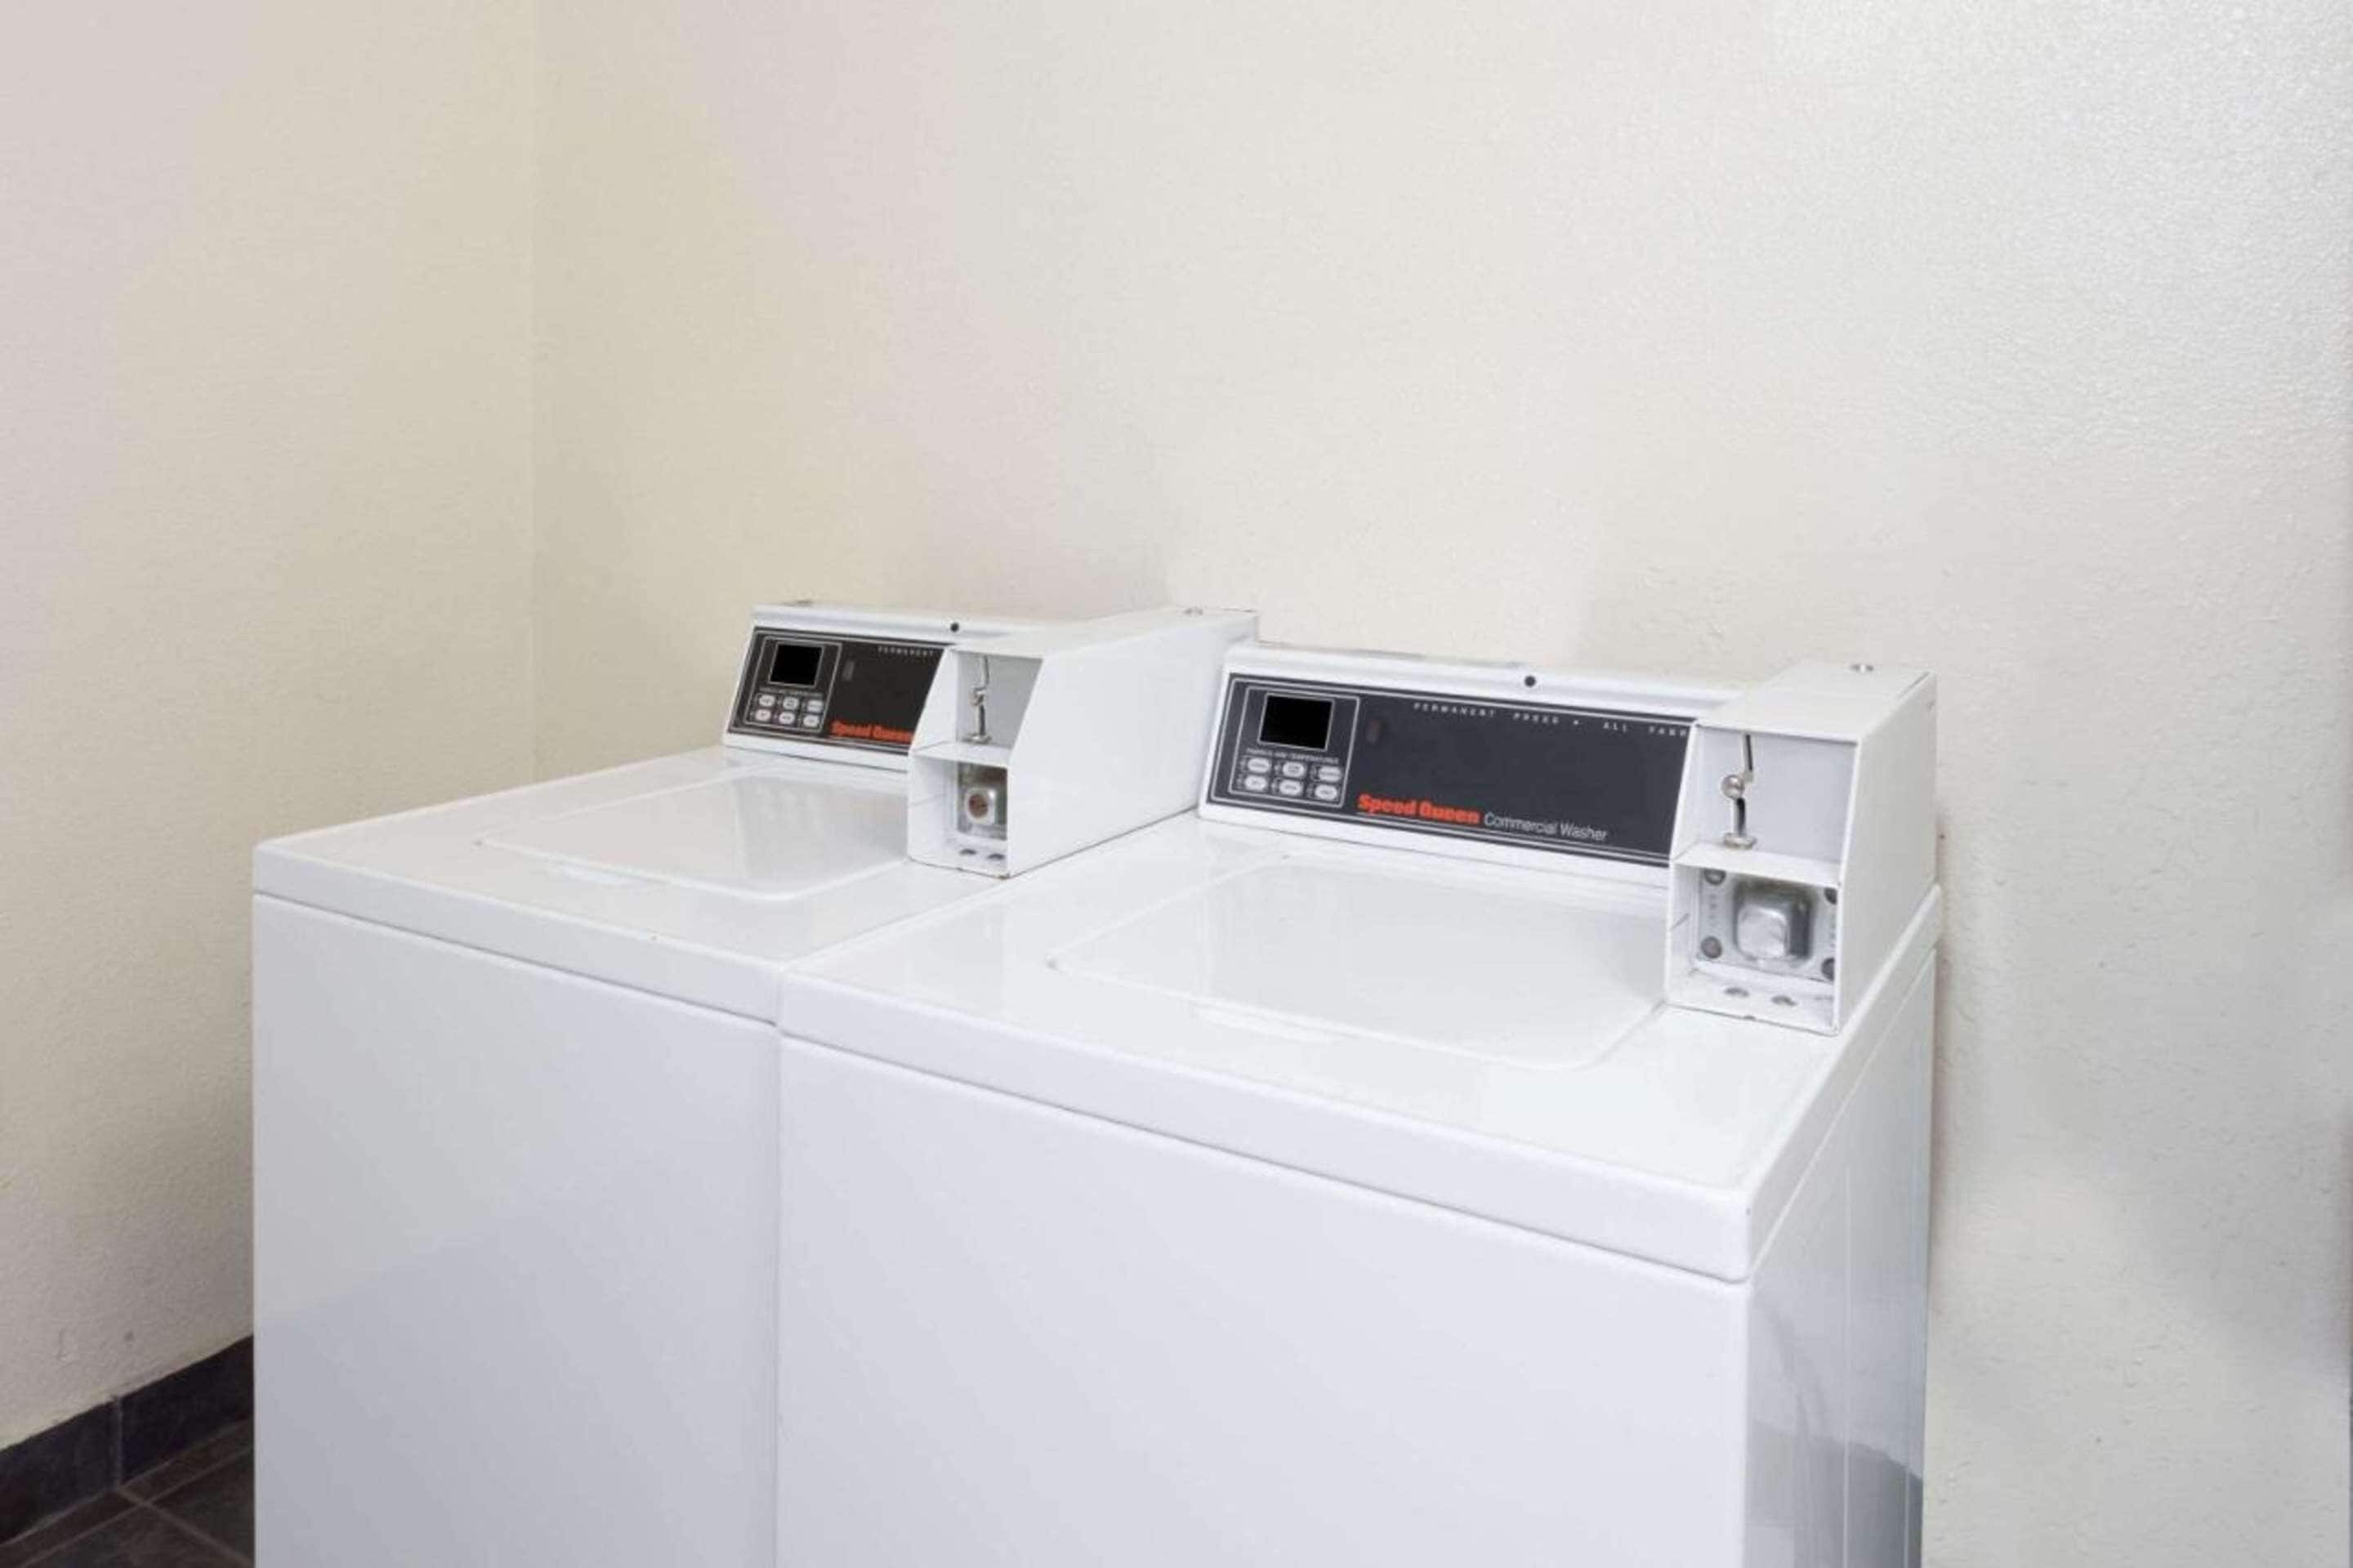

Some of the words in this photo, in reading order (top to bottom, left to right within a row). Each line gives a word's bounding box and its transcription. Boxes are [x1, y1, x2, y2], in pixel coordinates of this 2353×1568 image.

[831, 720, 872, 739] Speed
[1413, 701, 1496, 719] PERMANENT
[1512, 712, 1560, 726] PRESS
[1602, 721, 1629, 733] ALL
[1357, 793, 1418, 815] Speed
[1418, 800, 1480, 824] Queen
[1483, 811, 1558, 834] Commercial
[1560, 821, 1608, 842] Washer
